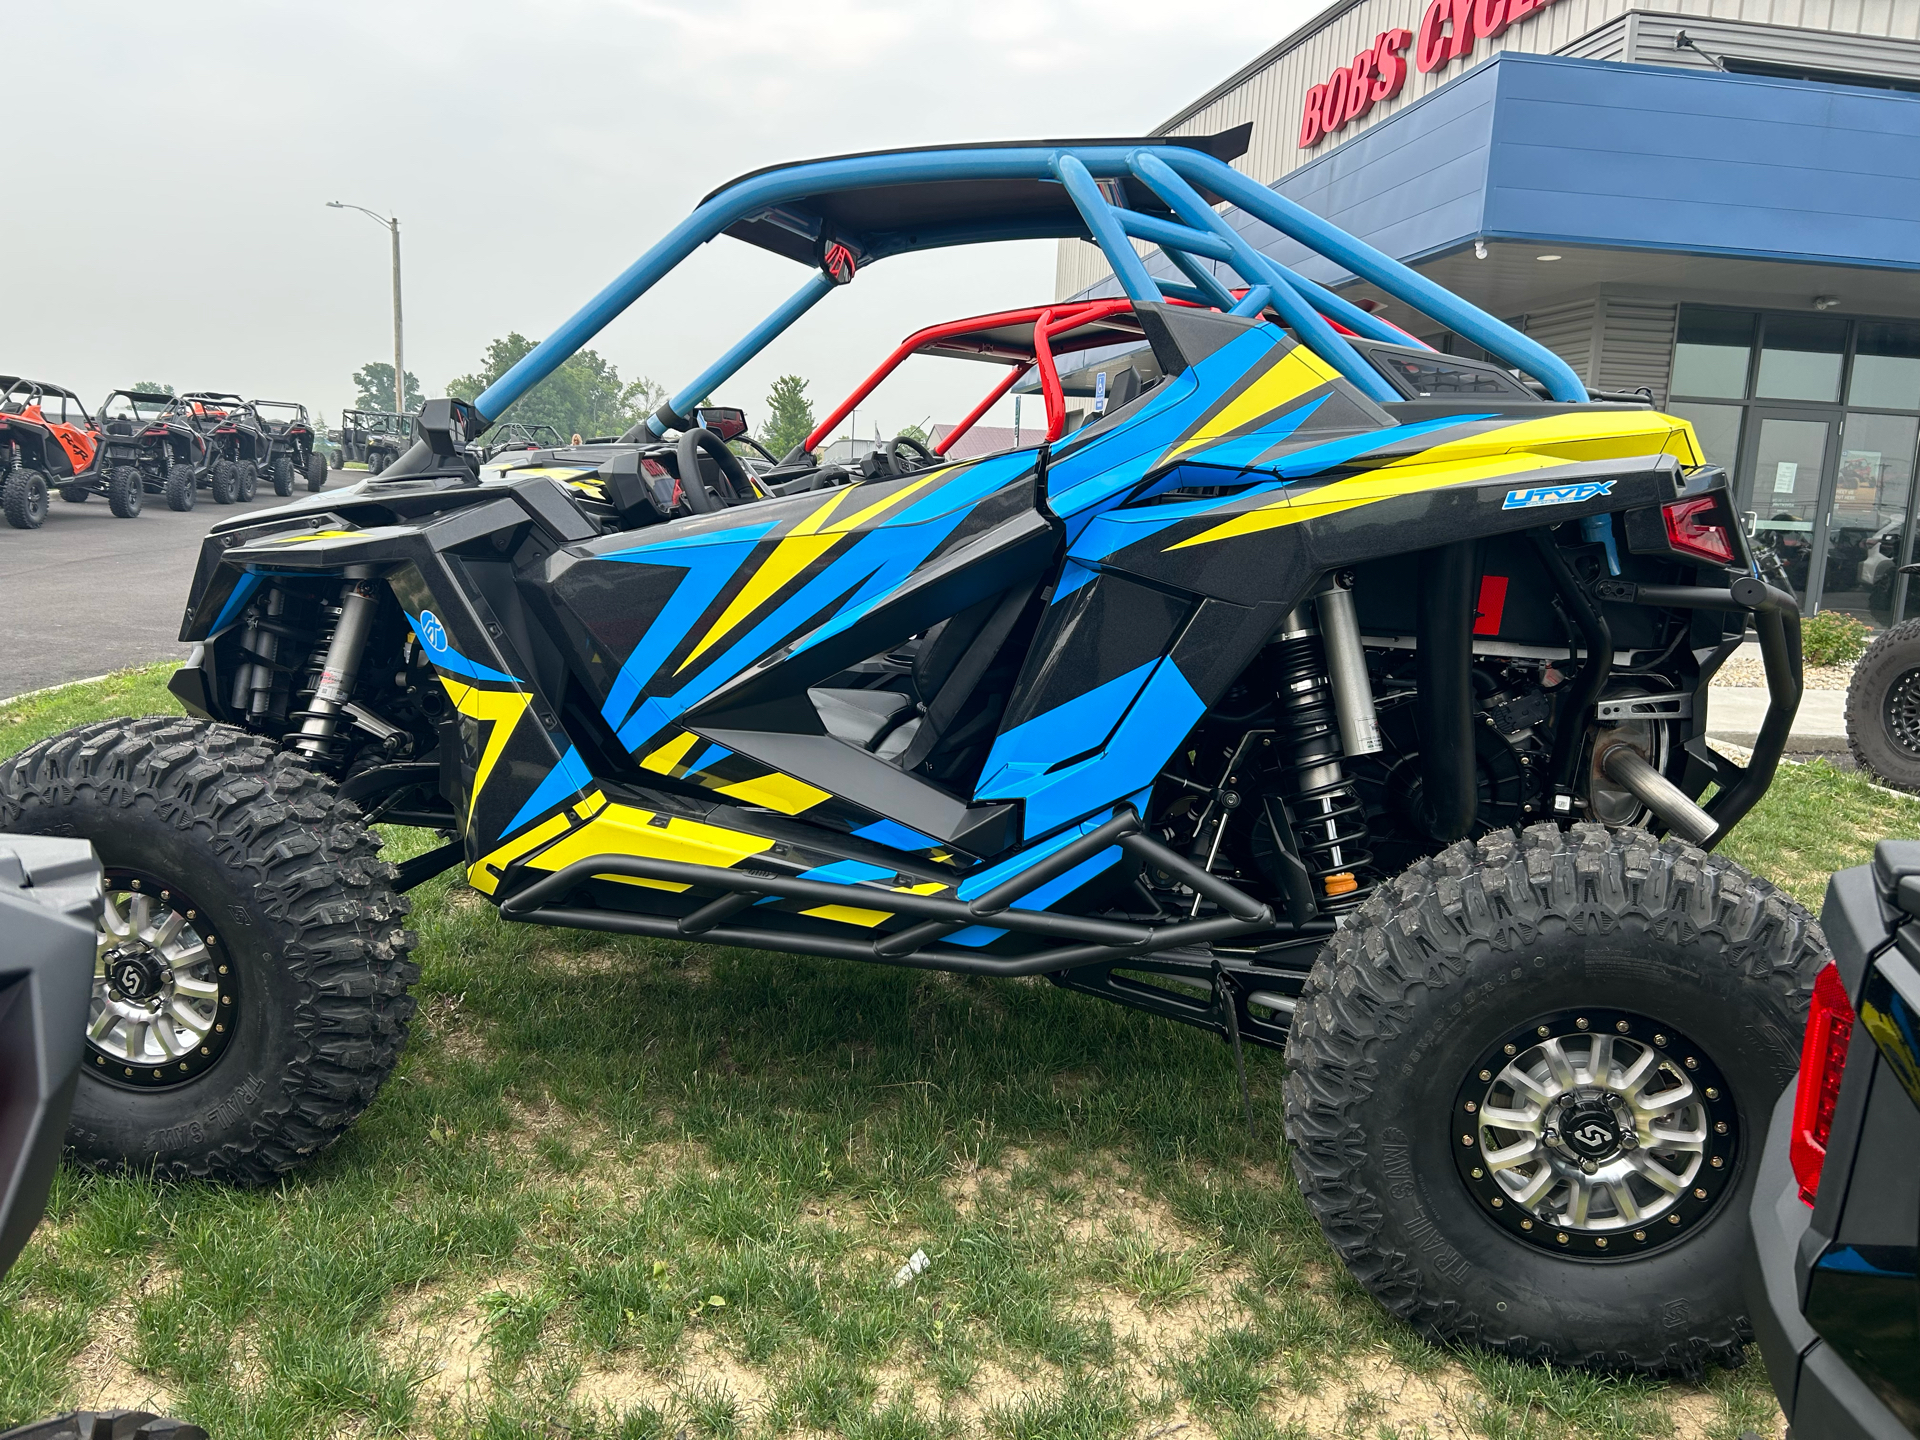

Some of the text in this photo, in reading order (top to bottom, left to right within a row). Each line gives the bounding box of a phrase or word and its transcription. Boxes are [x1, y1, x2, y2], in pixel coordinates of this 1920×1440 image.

[1299, 0, 1556, 149] BOB'S CYC
[1505, 480, 1617, 505] UTVFX
[208, 1072, 266, 1130] TRAIL
[157, 1120, 205, 1151] SAW
[1381, 1143, 1472, 1286] TRAIL SAW
